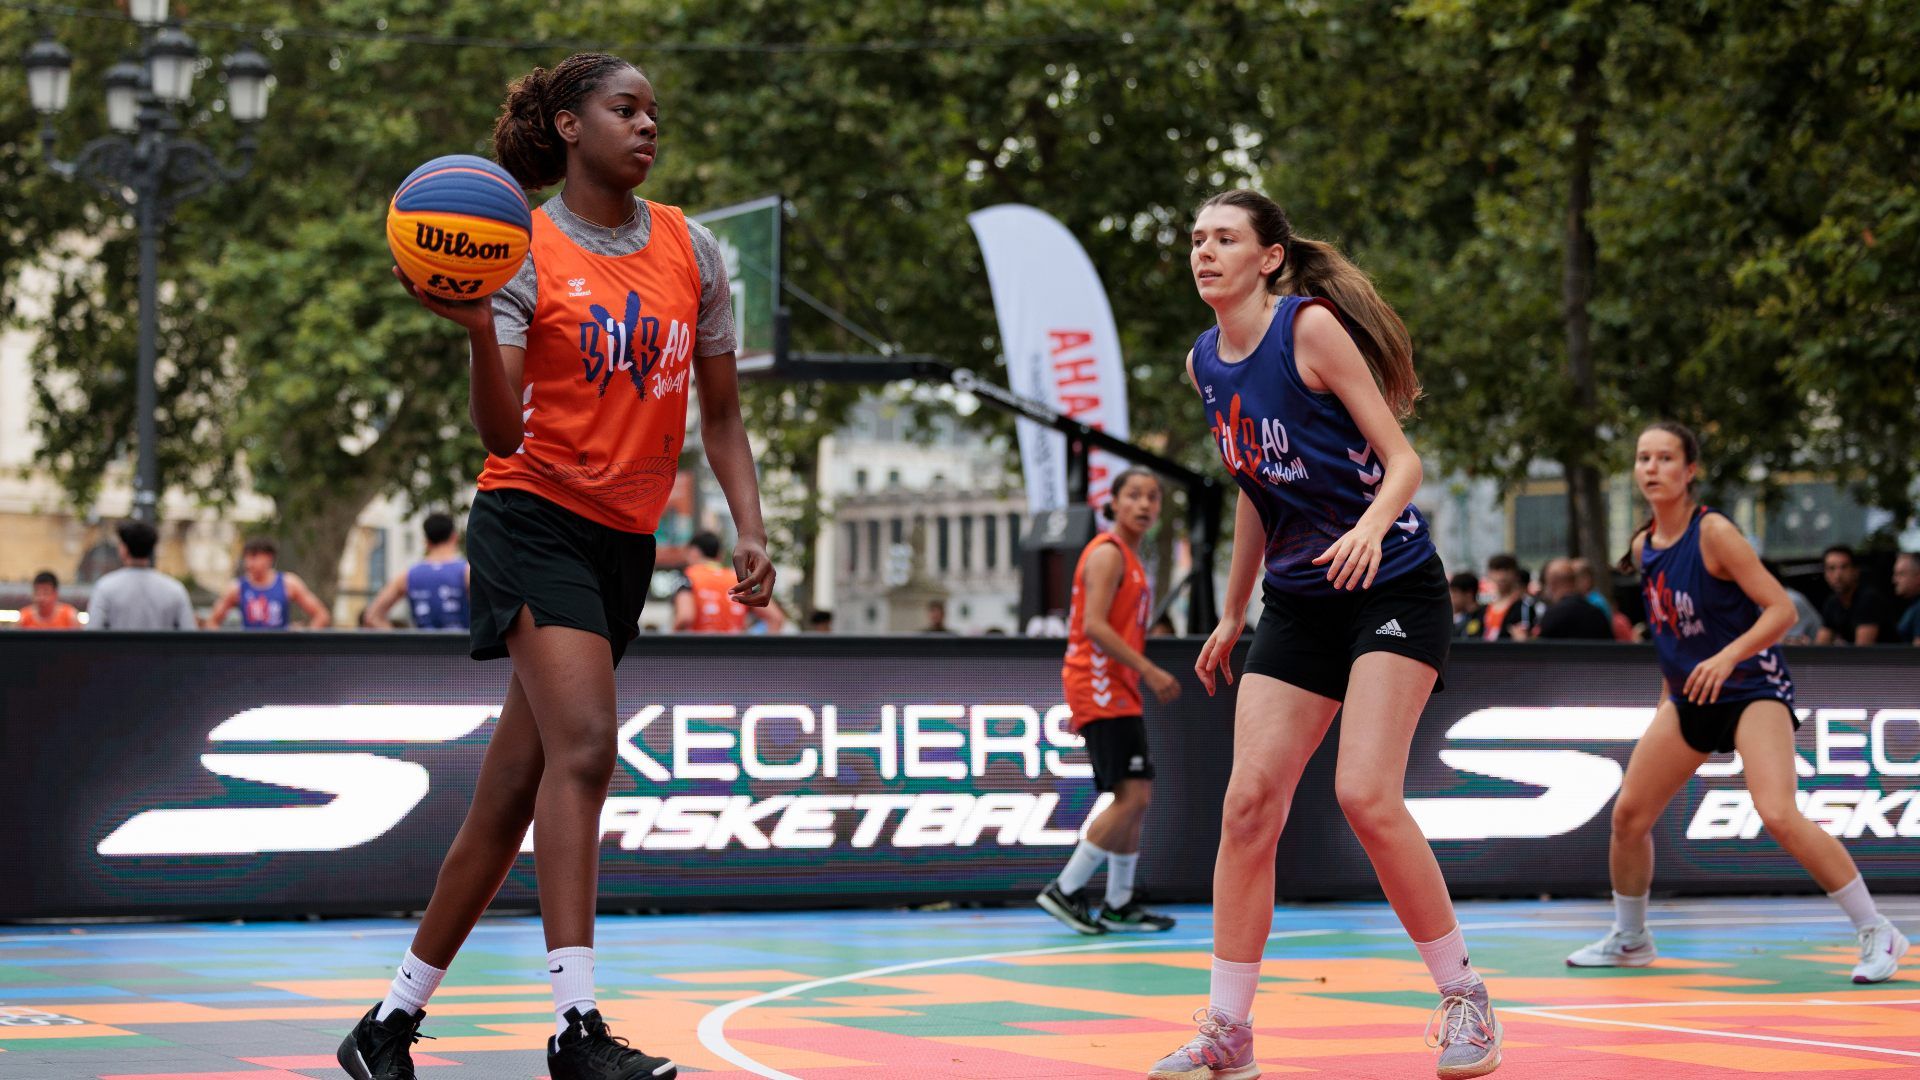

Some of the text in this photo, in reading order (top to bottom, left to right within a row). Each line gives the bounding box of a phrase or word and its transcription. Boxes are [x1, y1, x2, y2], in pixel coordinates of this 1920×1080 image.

[416, 222, 510, 259] Wilson
[1375, 629, 1407, 638] adidas
[617, 704, 1096, 782] KECHERS
